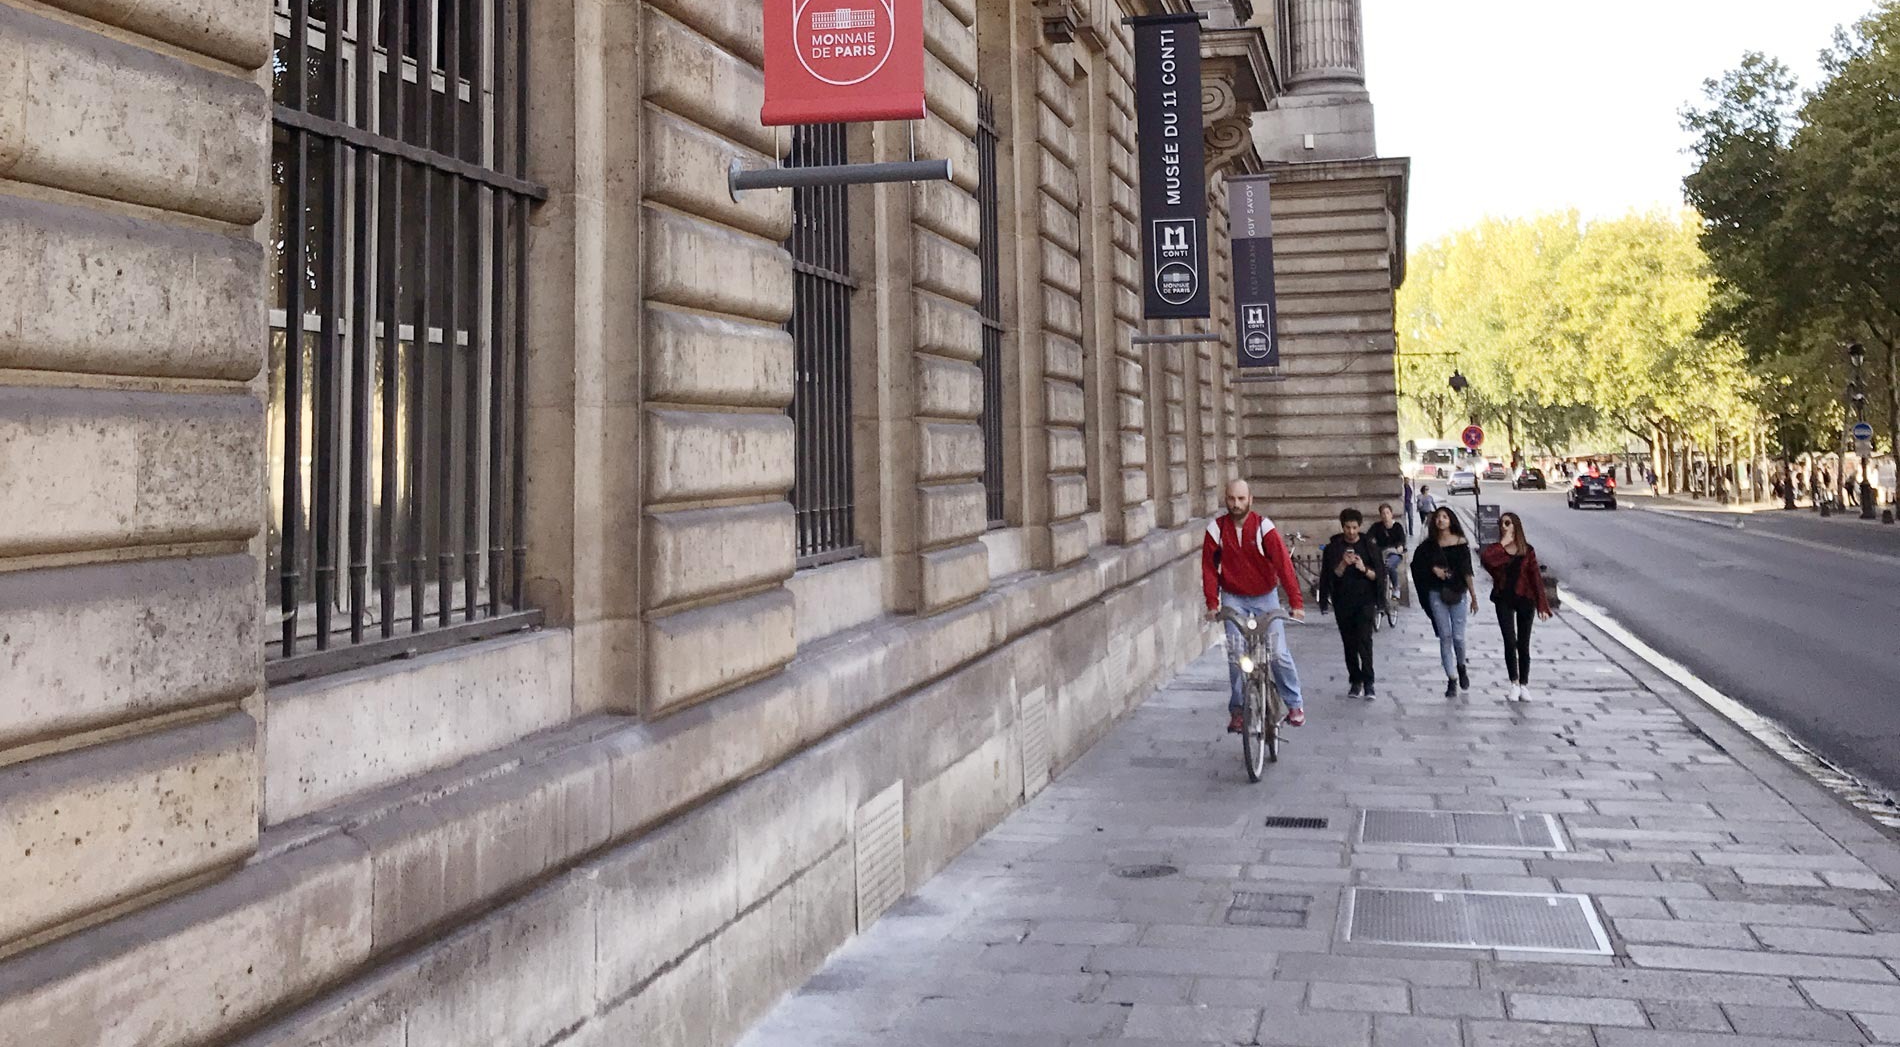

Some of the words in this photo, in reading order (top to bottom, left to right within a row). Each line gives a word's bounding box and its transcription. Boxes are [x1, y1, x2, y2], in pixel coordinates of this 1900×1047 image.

[812, 32, 876, 46] MONNAIE
[812, 47, 831, 59] DE
[835, 45, 876, 58] PARIS
[1160, 29, 1176, 85] CONTI
[1163, 90, 1177, 107] 11
[1163, 114, 1178, 138] DU
[1161, 143, 1181, 205] MUSÉE
[1246, 184, 1255, 214] SAVOY
[1248, 218, 1256, 237] GUY
